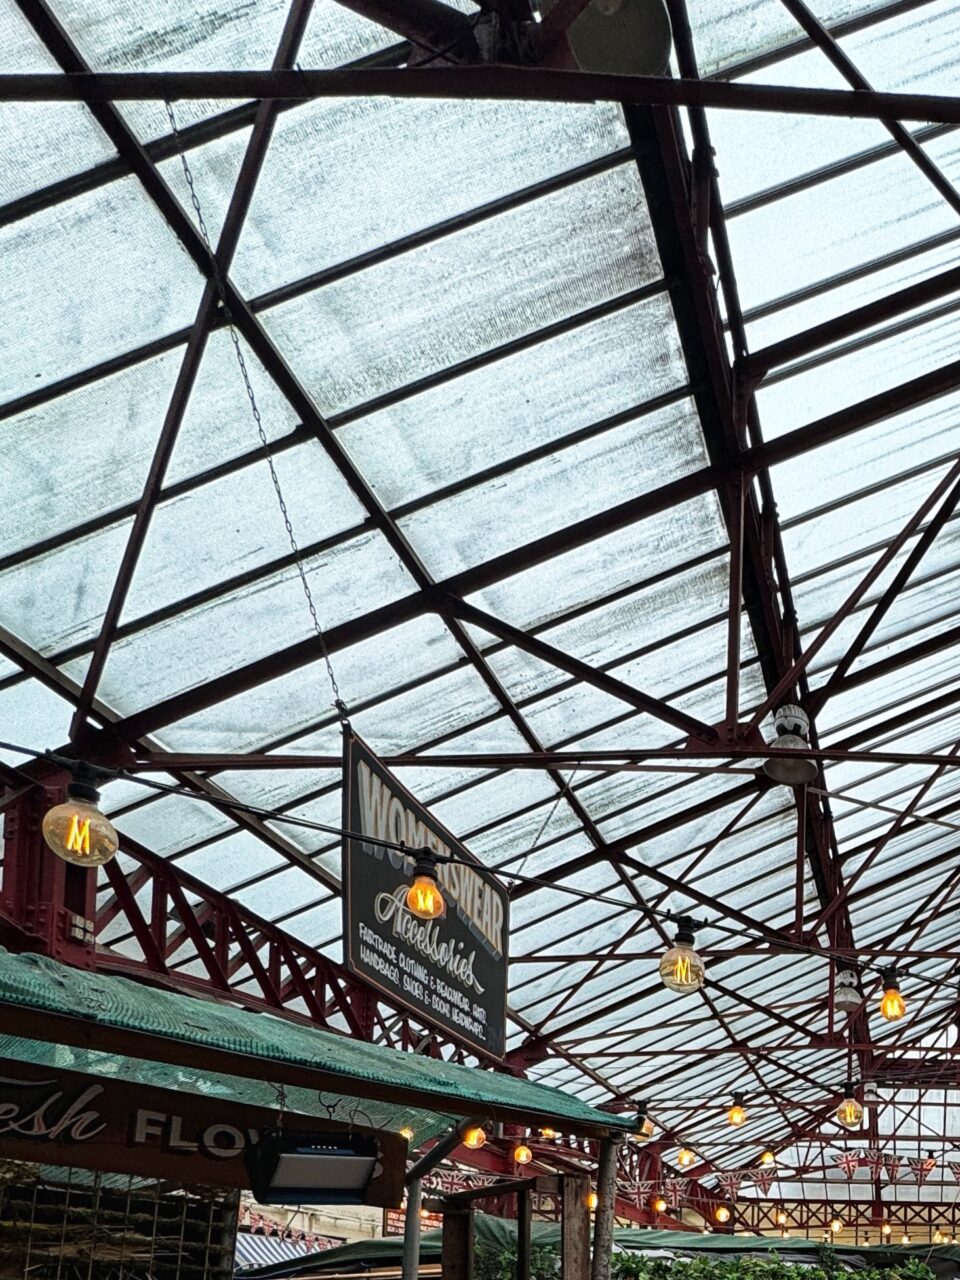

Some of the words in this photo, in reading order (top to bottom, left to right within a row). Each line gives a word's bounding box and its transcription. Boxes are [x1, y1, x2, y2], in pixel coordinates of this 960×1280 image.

[359, 922, 397, 962] FAIRTRADE
[399, 952, 428, 984] CLOTHING
[403, 974, 424, 1000] SHOES
